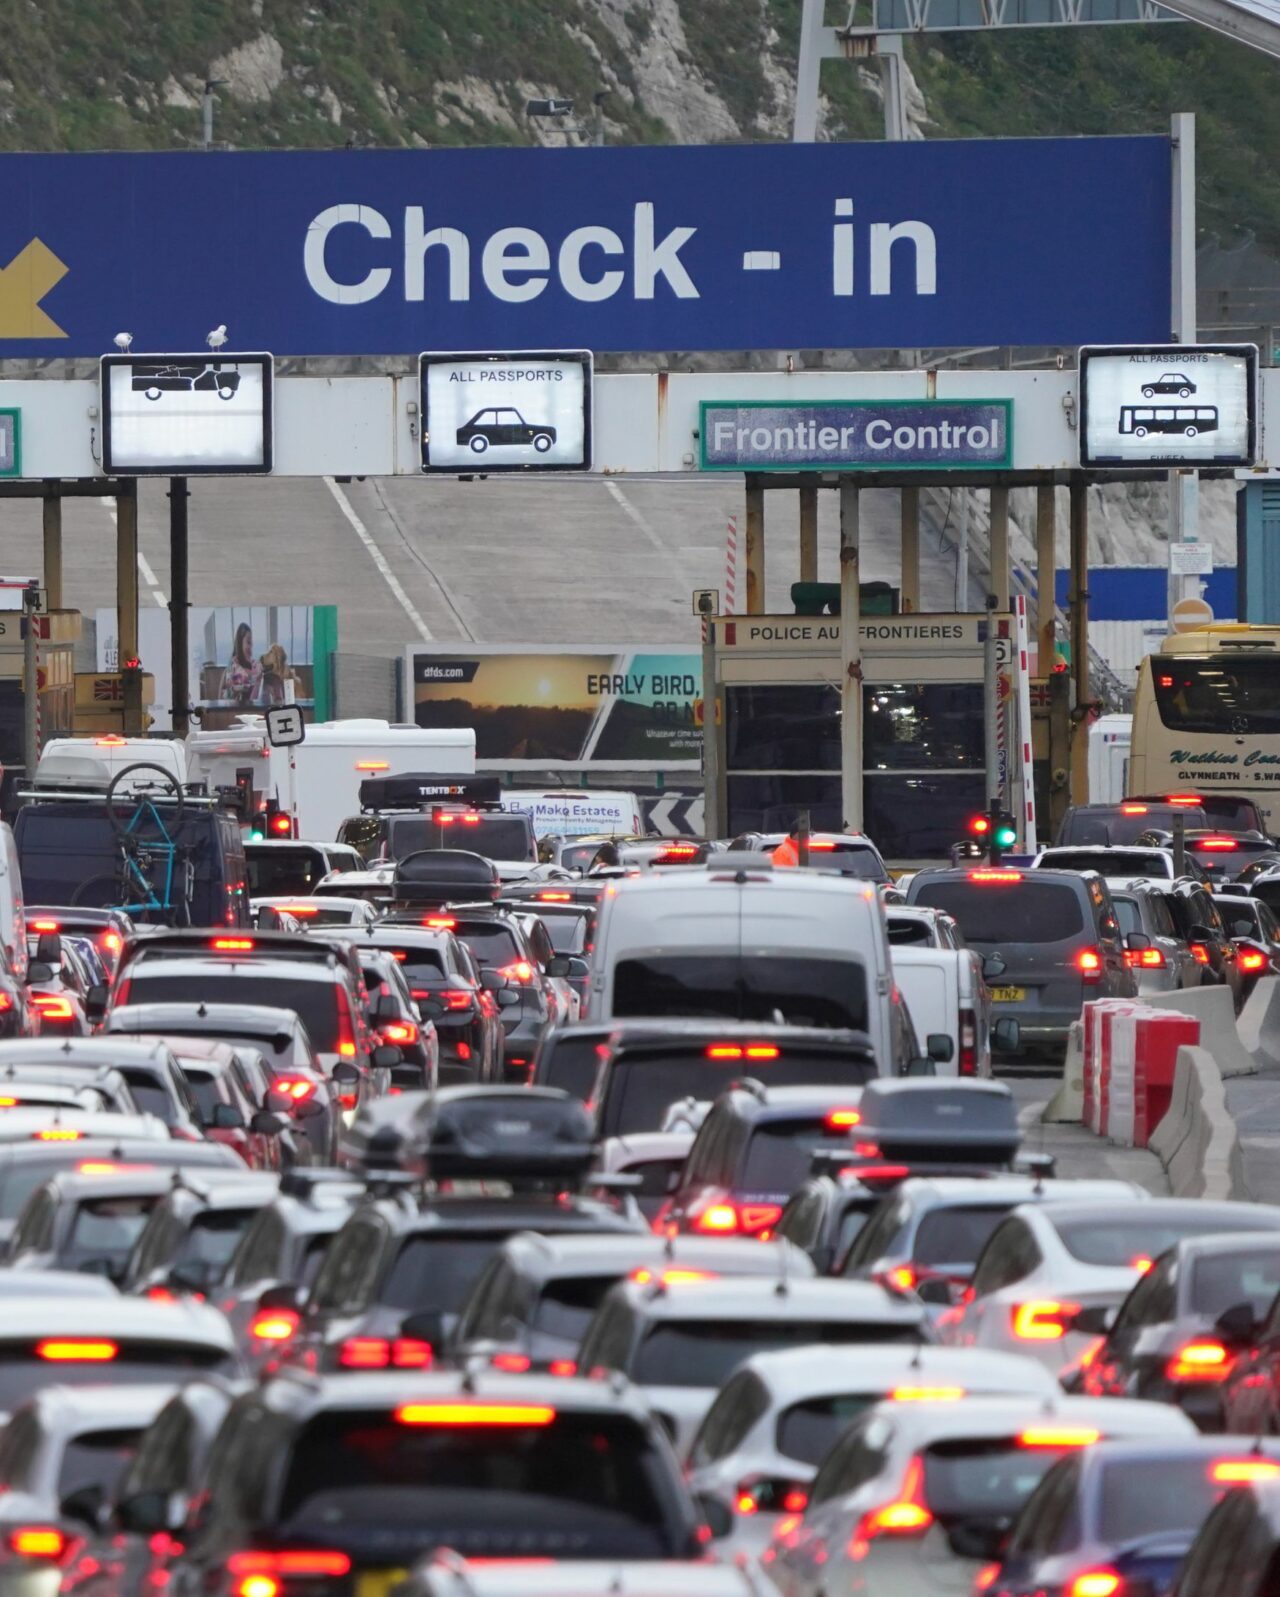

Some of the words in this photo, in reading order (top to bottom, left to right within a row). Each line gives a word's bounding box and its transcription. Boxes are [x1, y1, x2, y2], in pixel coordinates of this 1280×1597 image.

[303, 200, 701, 306] Check
[742, 249, 781, 272] -
[832, 197, 938, 297] in
[1129, 355, 1148, 363] ALL
[1150, 354, 1209, 363] PASSPORTS
[449, 370, 476, 382] ALL
[479, 369, 564, 382] PASSPORTS
[714, 420, 854, 451] Frontier
[865, 418, 999, 450] Control
[750, 626, 812, 641] POLICE
[817, 626, 840, 640] AU
[424, 666, 464, 678] dfds.com
[587, 674, 645, 695] EARLY
[652, 674, 700, 698] BIRD,
[1178, 771, 1240, 780] GLYNNEATH
[1254, 772, 1280, 781] S.WA
[419, 785, 465, 796] TENTBOX
[535, 804, 570, 817] Mako
[573, 805, 621, 817] Estates
